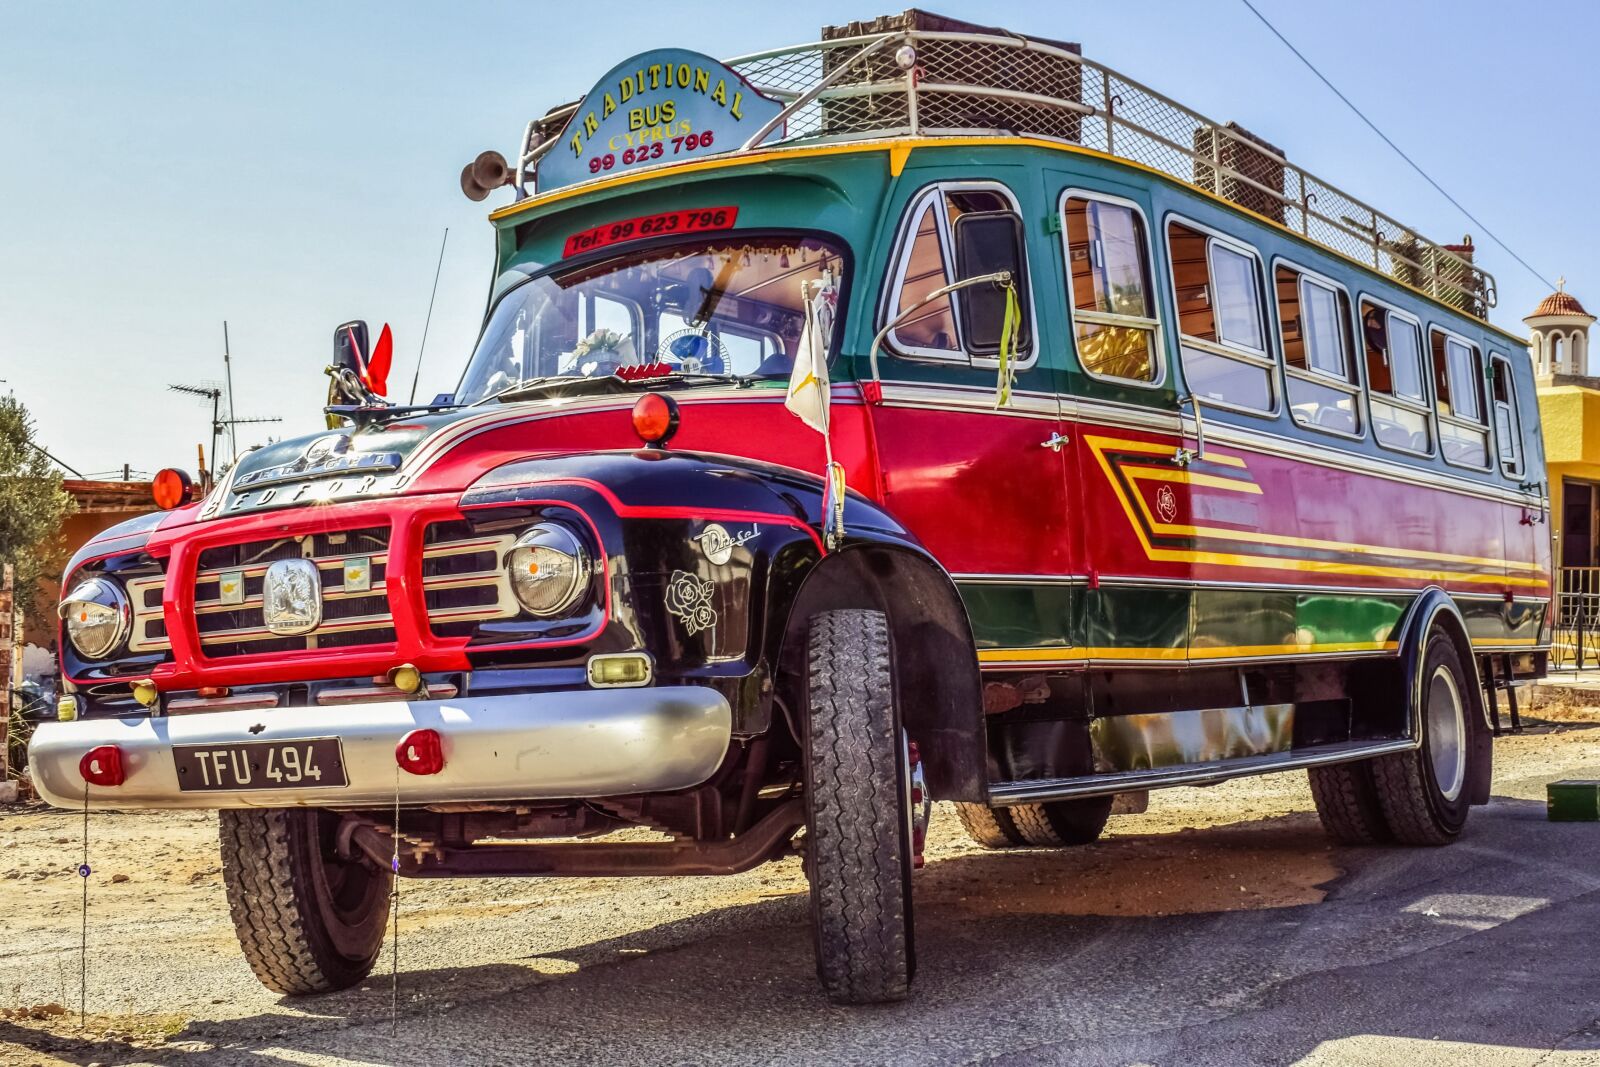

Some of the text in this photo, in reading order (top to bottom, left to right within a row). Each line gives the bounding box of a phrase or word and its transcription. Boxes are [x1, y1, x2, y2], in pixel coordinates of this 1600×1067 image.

[570, 63, 744, 158] TRADITIONAL
[628, 100, 677, 131] BUS
[589, 131, 714, 173] 99 623 796
[609, 119, 692, 151] CYPRUS
[571, 209, 727, 251] Tel: 99 623 796
[202, 474, 412, 518] BEDFORD
[692, 523, 761, 555] Diesel
[194, 746, 322, 786] TFU 494
